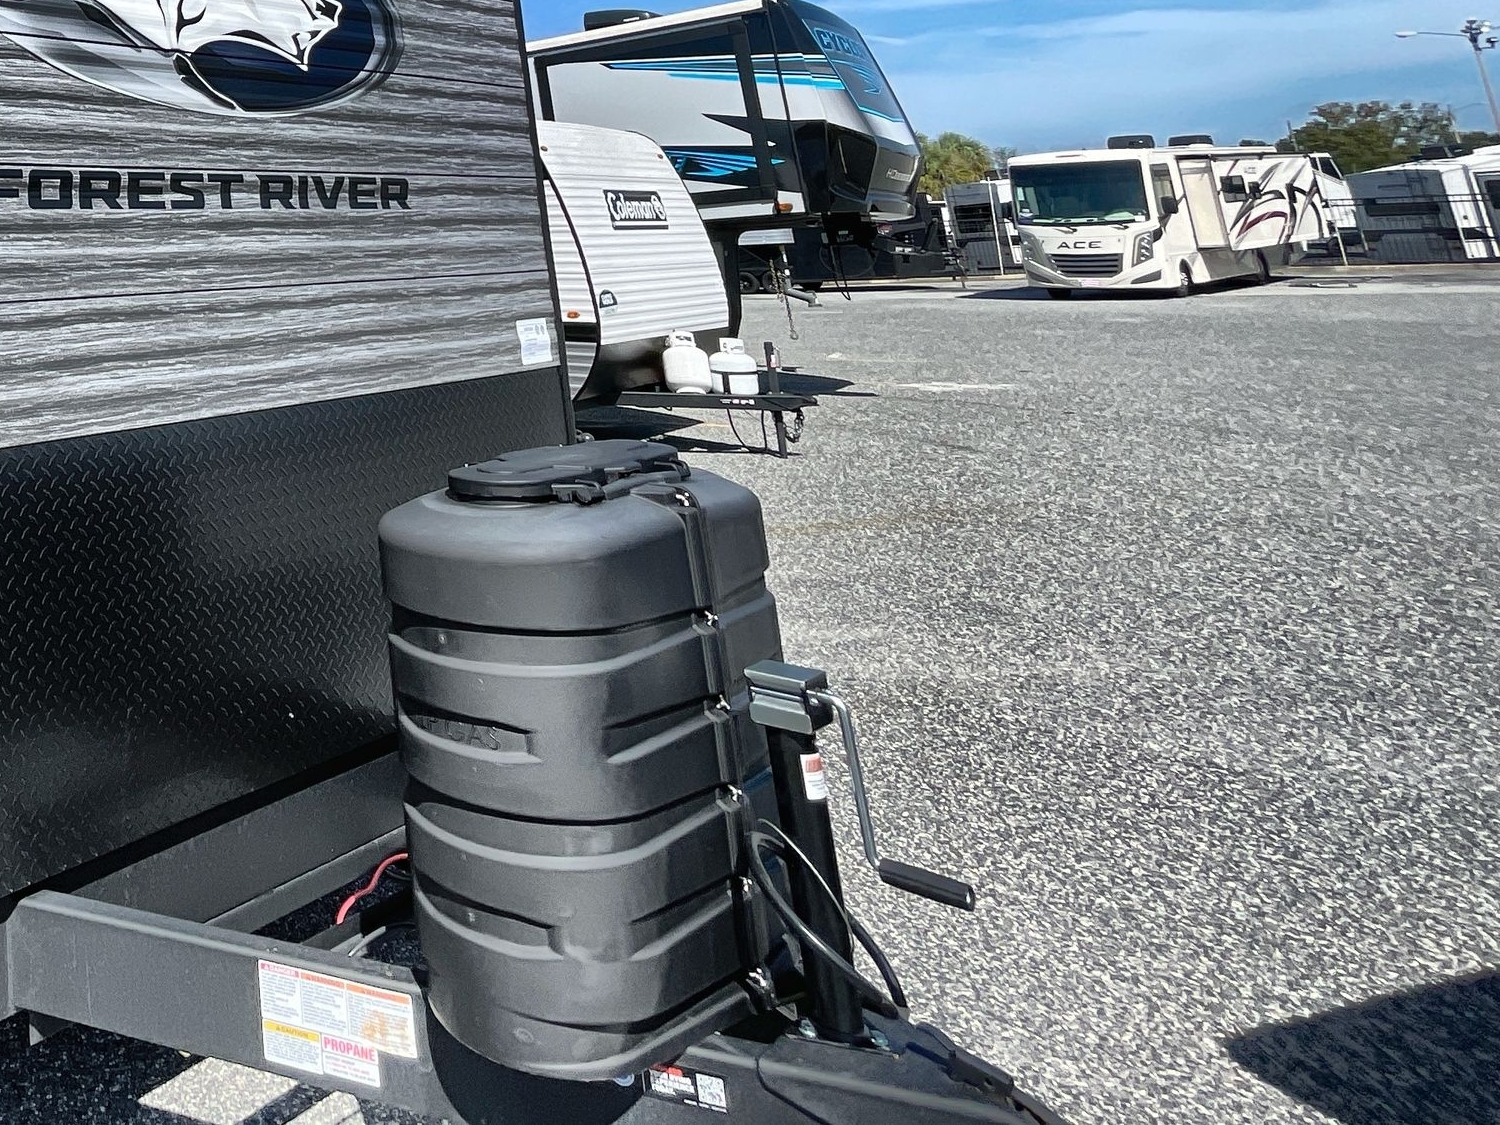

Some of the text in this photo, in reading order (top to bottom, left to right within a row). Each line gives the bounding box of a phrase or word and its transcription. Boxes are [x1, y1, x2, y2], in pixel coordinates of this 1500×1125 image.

[255, 174, 412, 211] RIVER
[606, 191, 658, 221] Coleman
[323, 1036, 376, 1062] PROPANE
